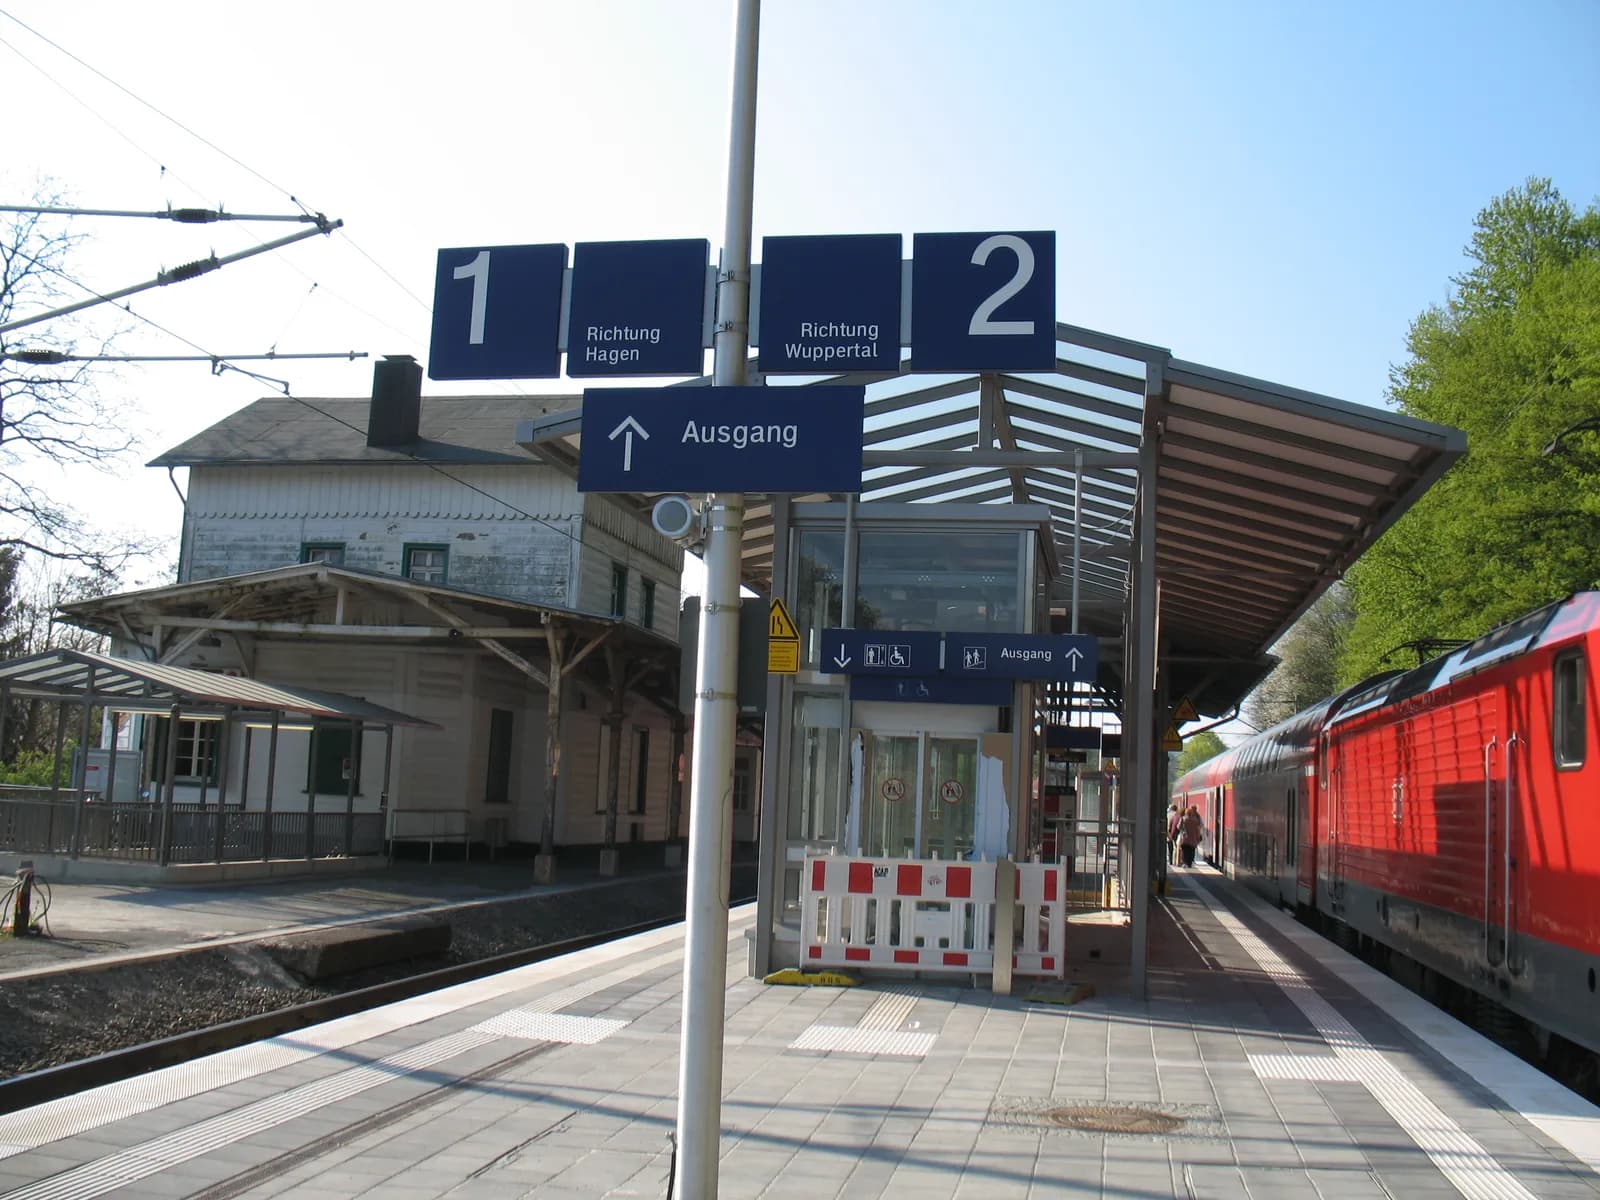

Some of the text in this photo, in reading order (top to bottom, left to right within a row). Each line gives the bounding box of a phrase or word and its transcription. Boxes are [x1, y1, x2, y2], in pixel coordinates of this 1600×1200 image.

[969, 234, 1035, 335] 2
[453, 250, 491, 344] 1
[588, 326, 660, 345] Richtung
[802, 322, 878, 341] Richtung
[586, 346, 640, 365] Hagen
[785, 343, 878, 362] Wuppertal
[682, 421, 797, 448] Ausgang
[1001, 648, 1051, 661] Ausgang
